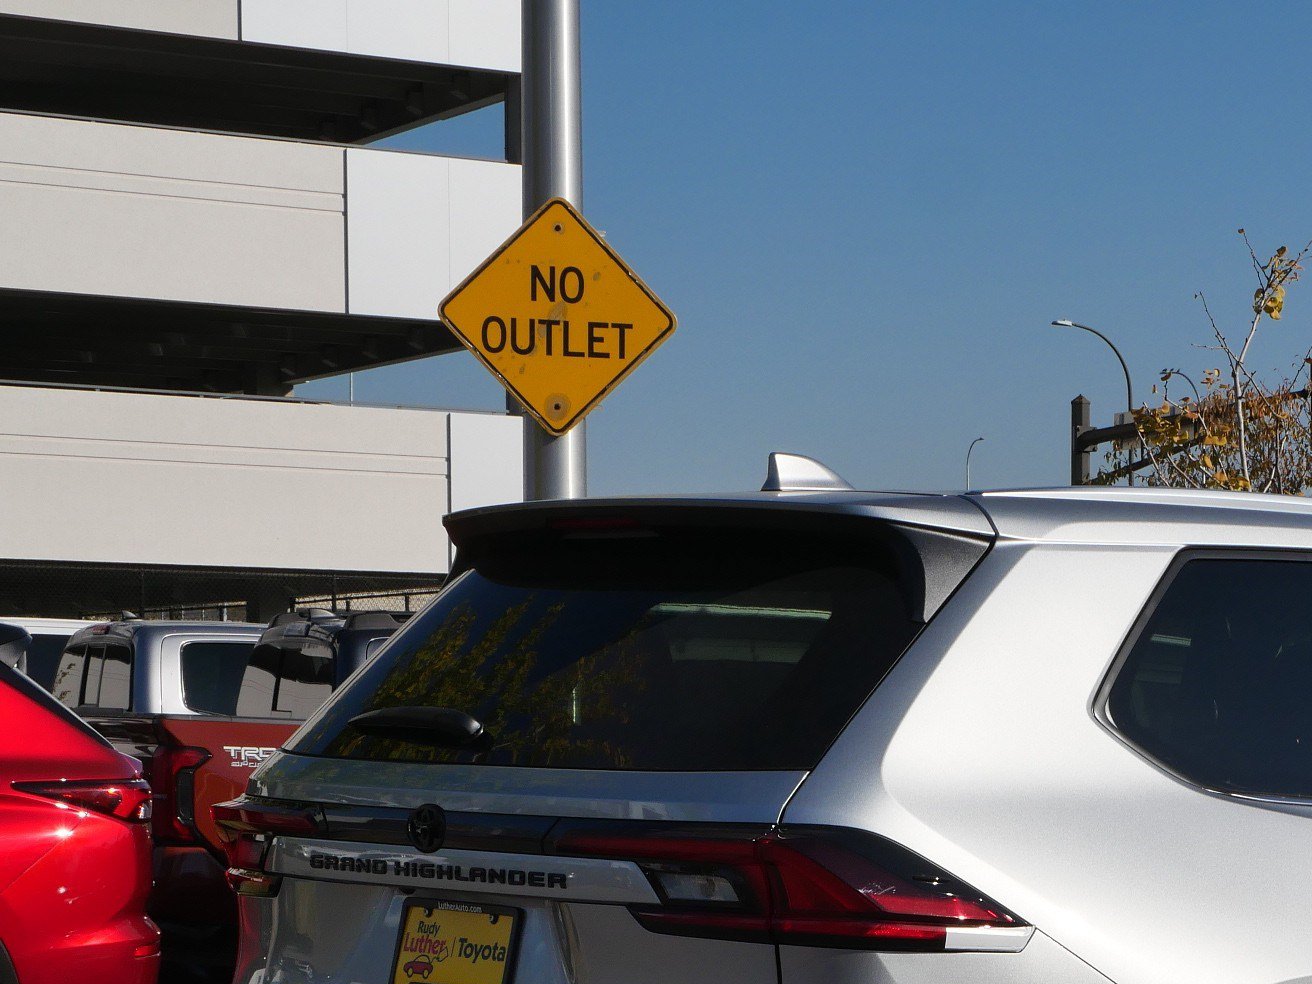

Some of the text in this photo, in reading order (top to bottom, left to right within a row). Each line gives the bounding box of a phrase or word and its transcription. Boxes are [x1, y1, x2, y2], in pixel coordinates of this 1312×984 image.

[530, 264, 585, 304] NO
[481, 315, 634, 360] OUTLET
[309, 854, 568, 890] GRAND HIGHLANDER
[438, 901, 483, 914] LutherAuto.com
[417, 921, 440, 937] Rudy
[403, 931, 507, 964] Luther Toyota
